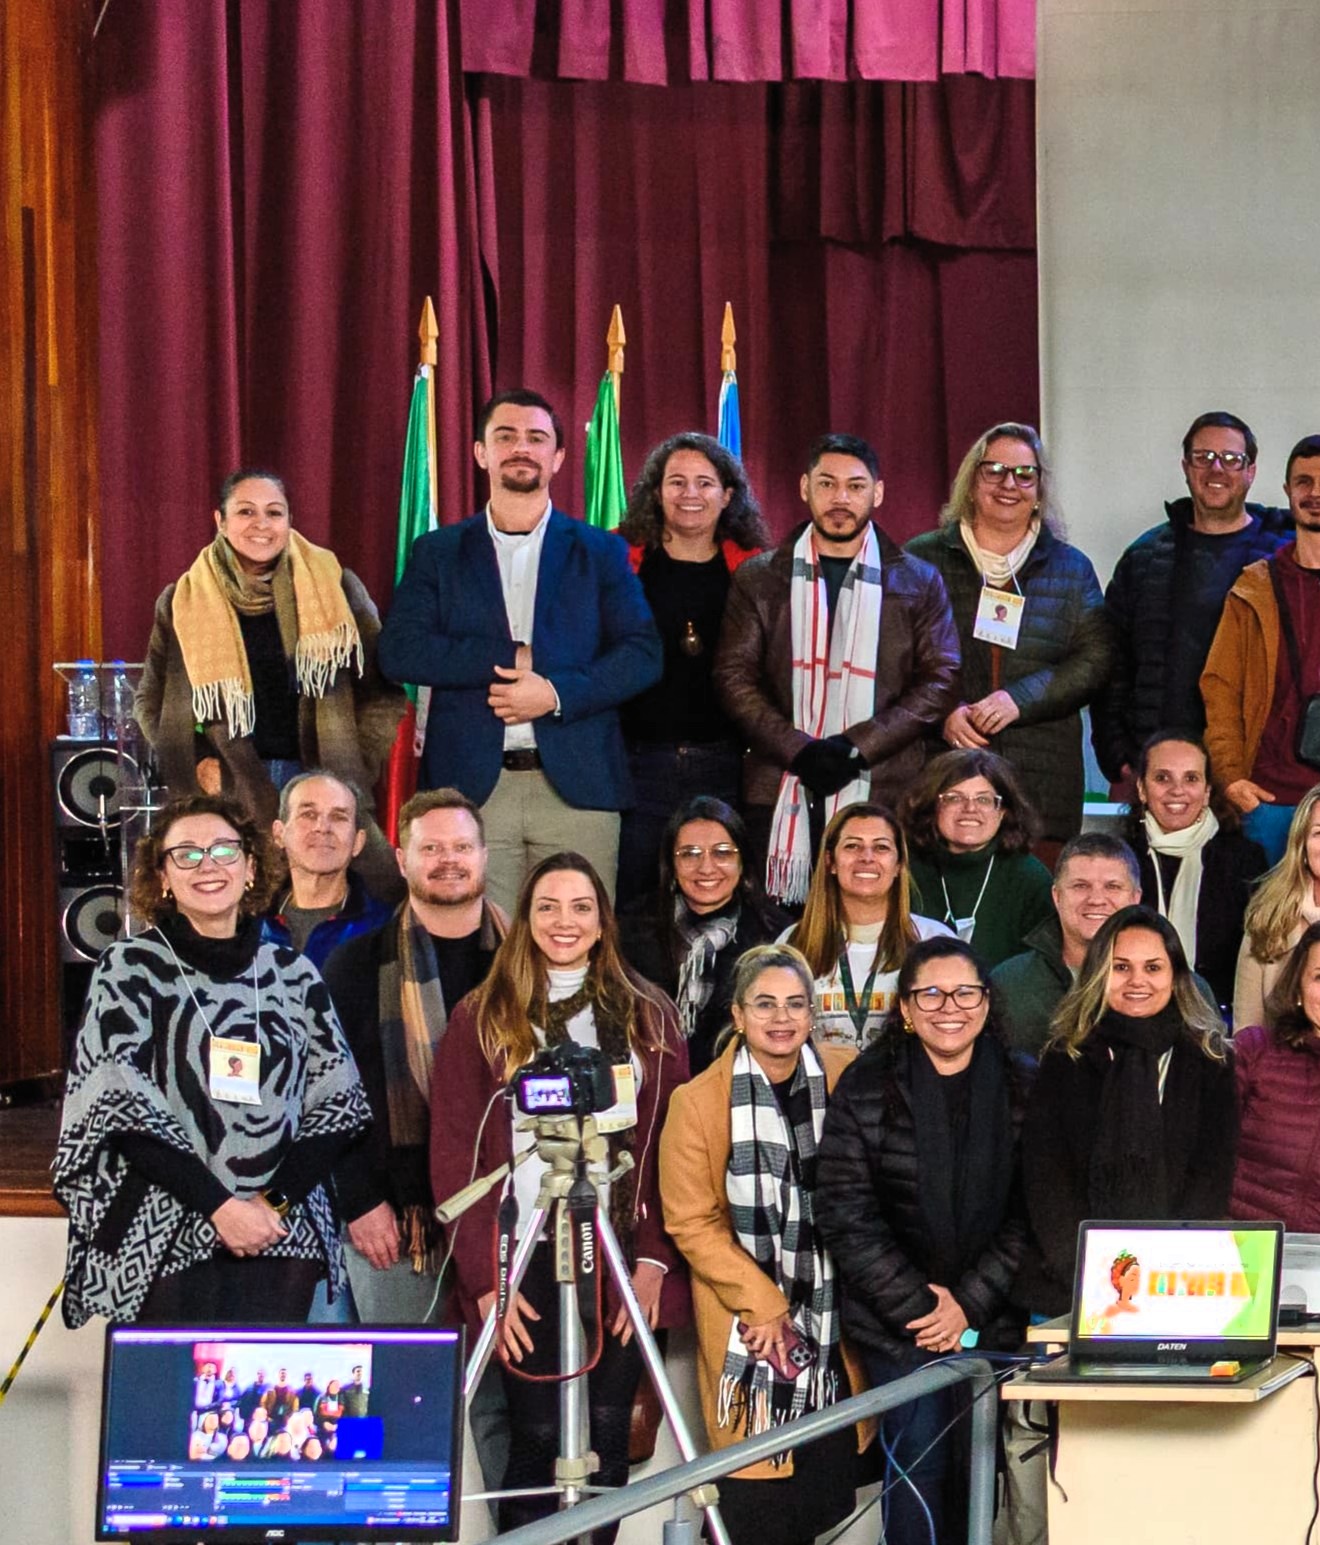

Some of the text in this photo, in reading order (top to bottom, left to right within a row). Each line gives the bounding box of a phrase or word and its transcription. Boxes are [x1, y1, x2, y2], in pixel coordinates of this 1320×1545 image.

[499, 1233, 509, 1263] EOS
[580, 1222, 595, 1274] Canon
[1157, 1343, 1187, 1351] DATEN
